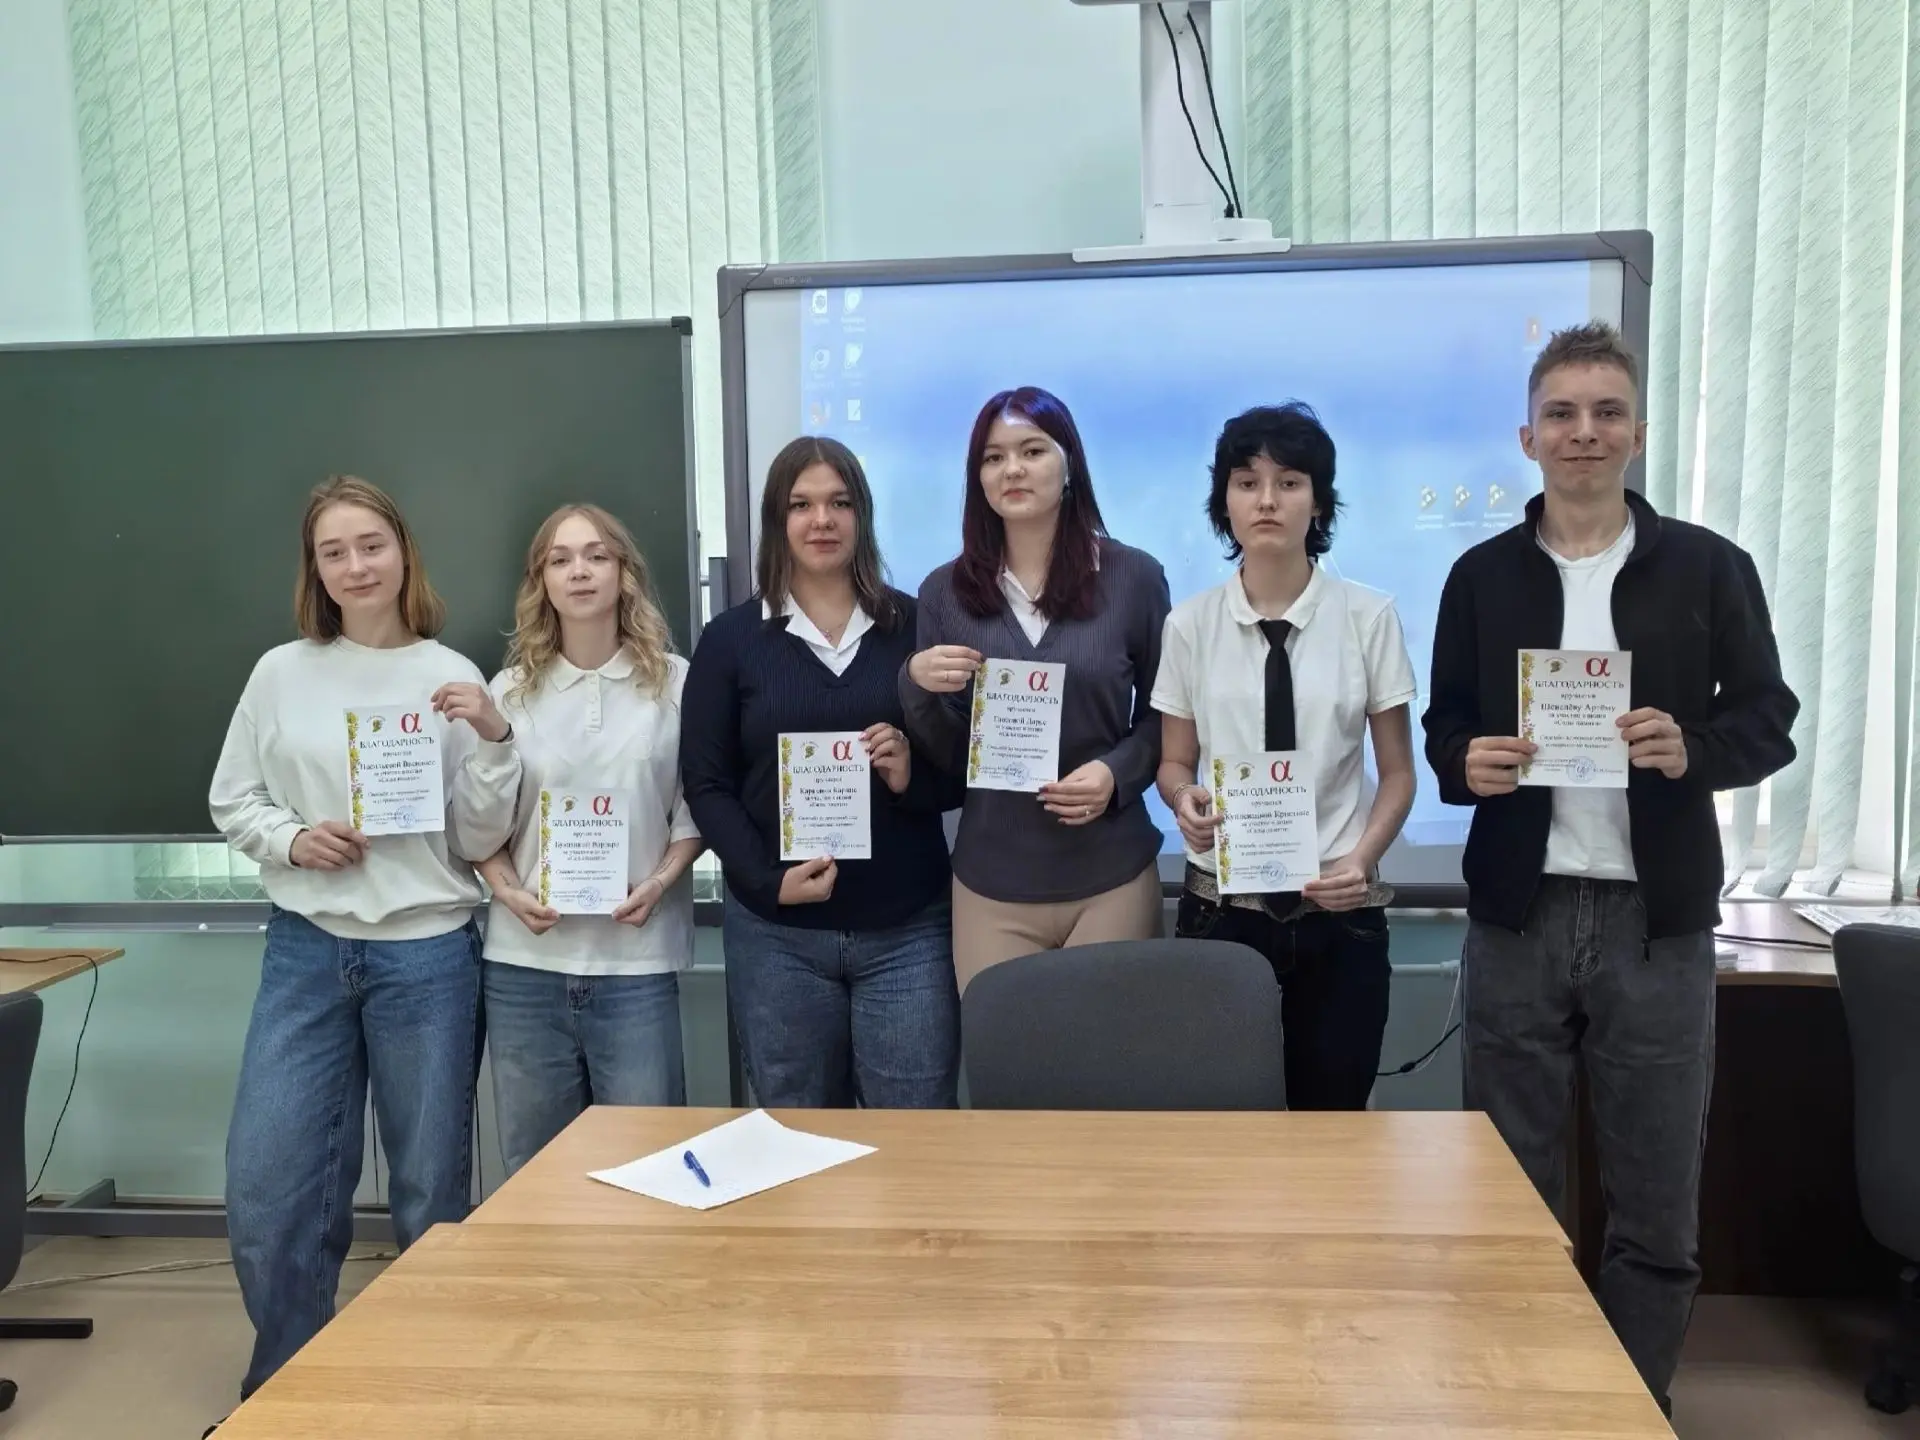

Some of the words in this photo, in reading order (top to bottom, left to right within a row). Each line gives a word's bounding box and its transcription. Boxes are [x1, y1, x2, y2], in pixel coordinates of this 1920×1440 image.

[1535, 680, 1624, 690] БЛАГОДАРНОСТЬ
[987, 692, 1058, 704] БЛАГОДАРНОСТЬ
[1584, 703, 1616, 712] Артёму
[360, 737, 434, 749] БЛАГОДАРНОСТЬ
[793, 764, 864, 774] БЛАГОДАРНОСТЬ
[1228, 786, 1306, 797] БЛАГОДАРНОСТЬ
[552, 819, 624, 828] БЛАГОДАРНОСТЬ
